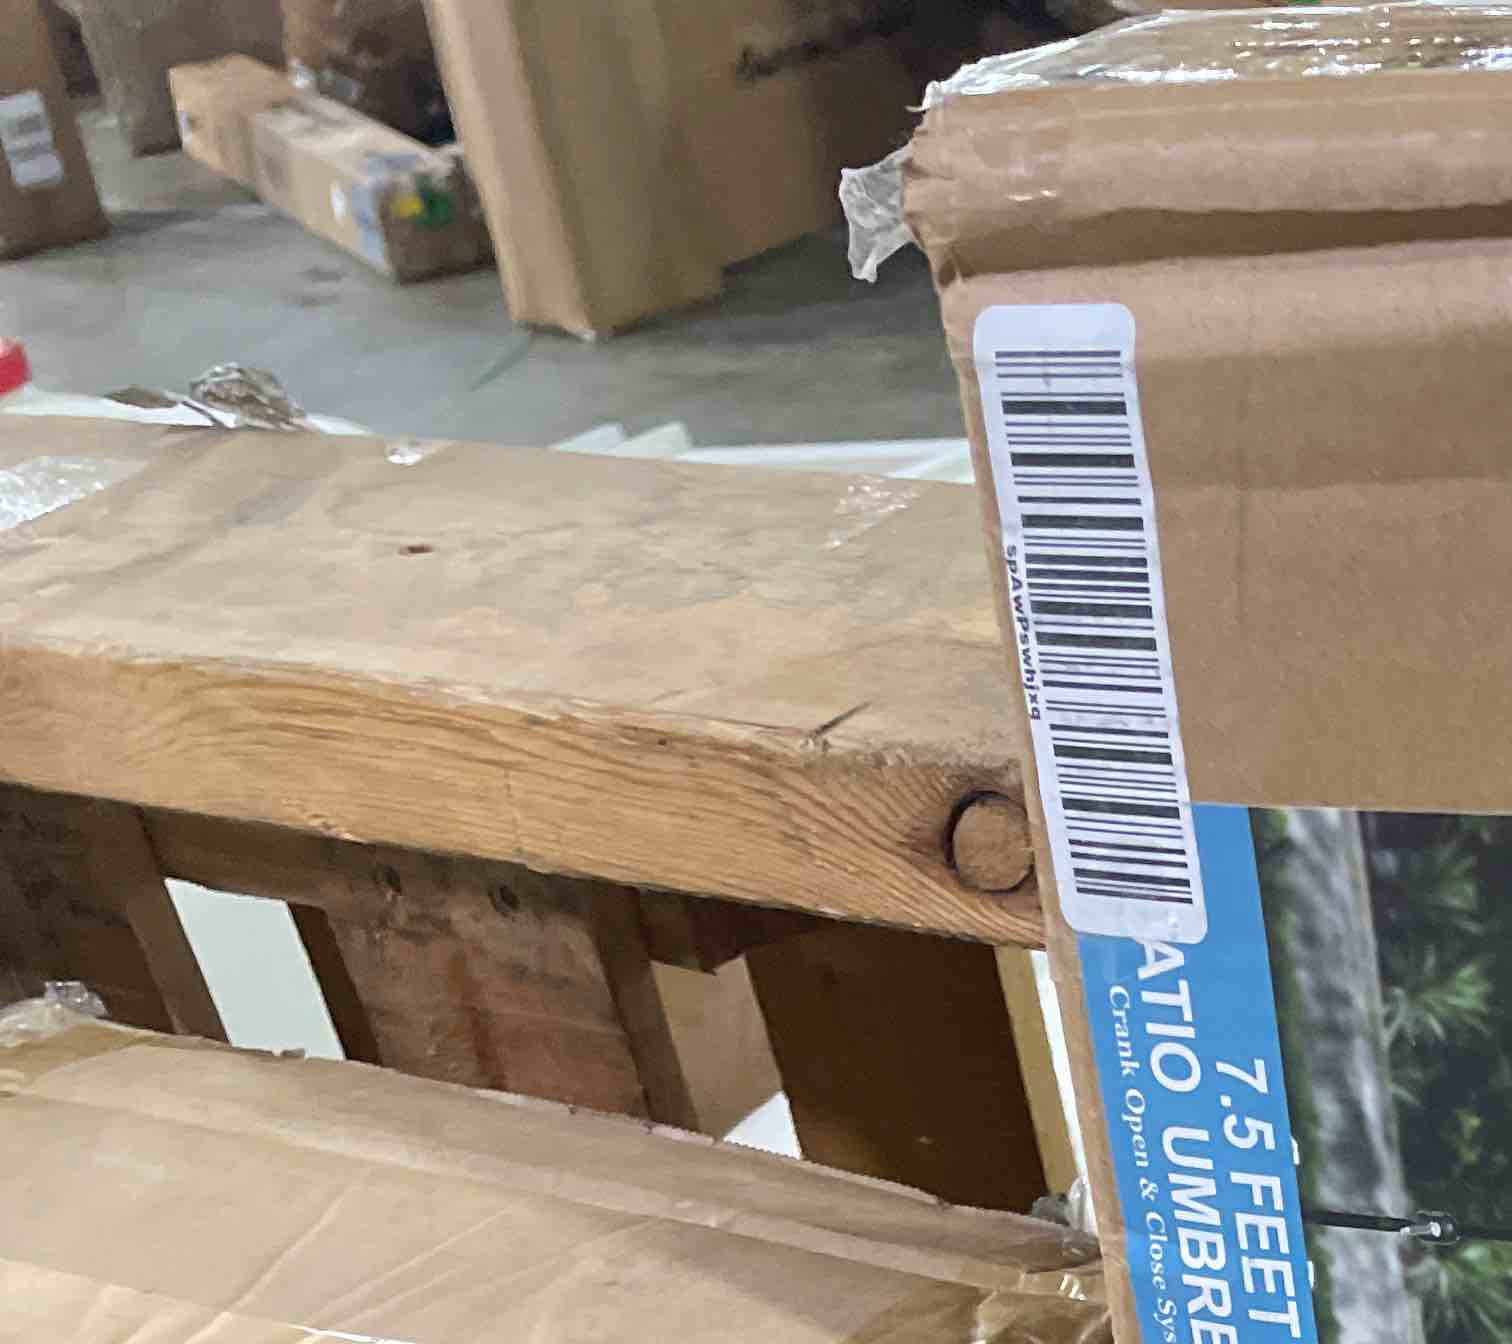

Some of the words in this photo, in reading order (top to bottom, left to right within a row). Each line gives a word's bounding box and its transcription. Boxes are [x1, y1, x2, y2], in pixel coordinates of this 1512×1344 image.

[1108, 985, 1139, 1079] Crank
[1136, 938, 1200, 1094] ATIO
[1124, 1086, 1147, 1170] Open
[1216, 1058, 1275, 1151] 7.5
[1139, 1177, 1157, 1200] &
[1144, 1210, 1168, 1294] Close
[1230, 1171, 1302, 1338] FEET
